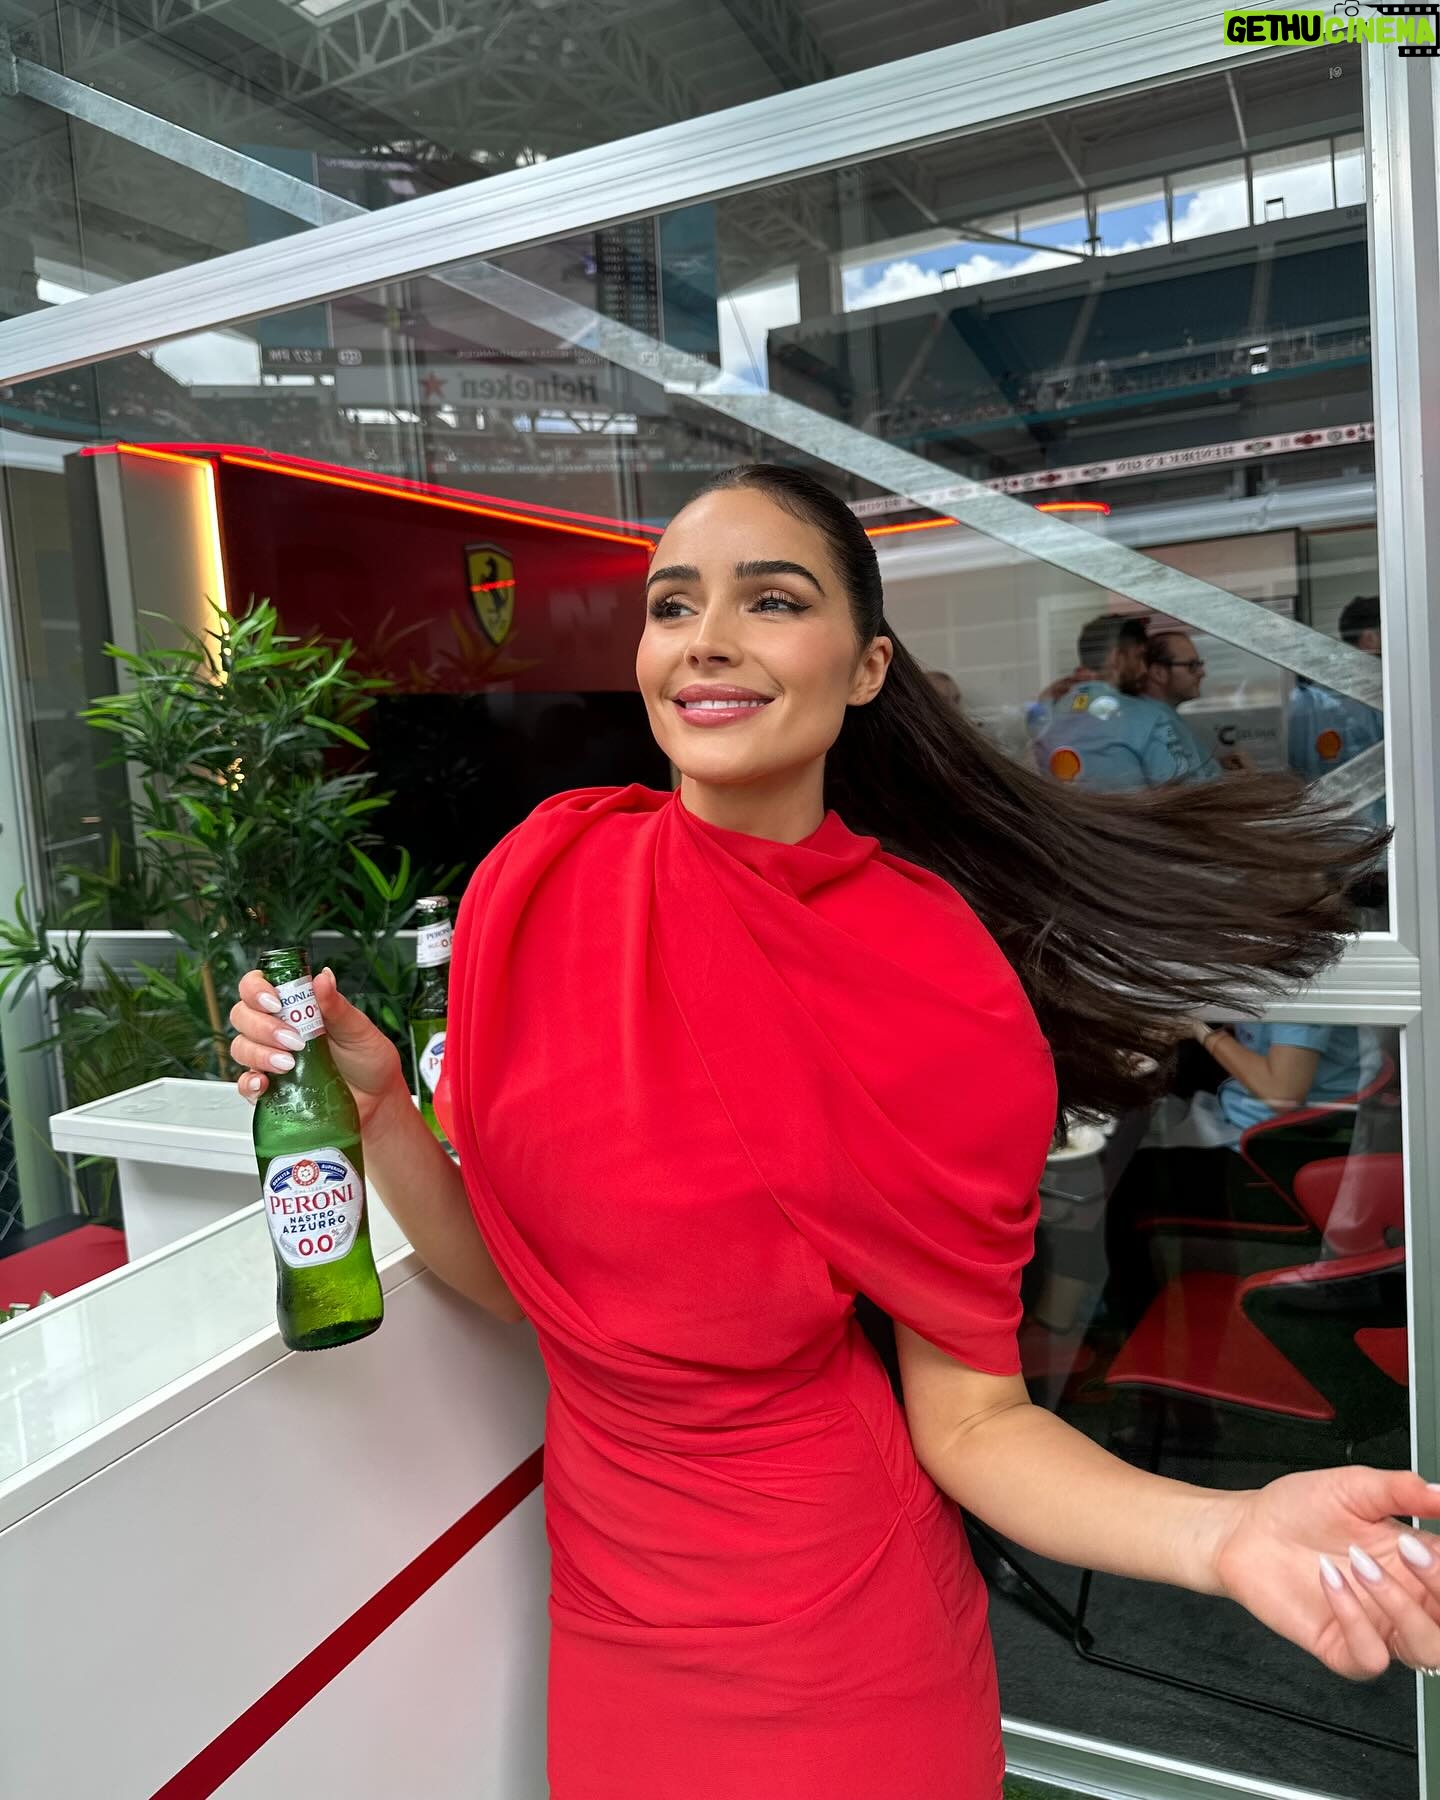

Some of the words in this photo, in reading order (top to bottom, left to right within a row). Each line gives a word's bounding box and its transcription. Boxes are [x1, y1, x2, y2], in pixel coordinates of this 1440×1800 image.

[280, 991, 307, 1007] RONI
[269, 1184, 355, 1215] PERONI
[282, 1215, 346, 1234] AZZURRO
[289, 1209, 335, 1224] NASTRO
